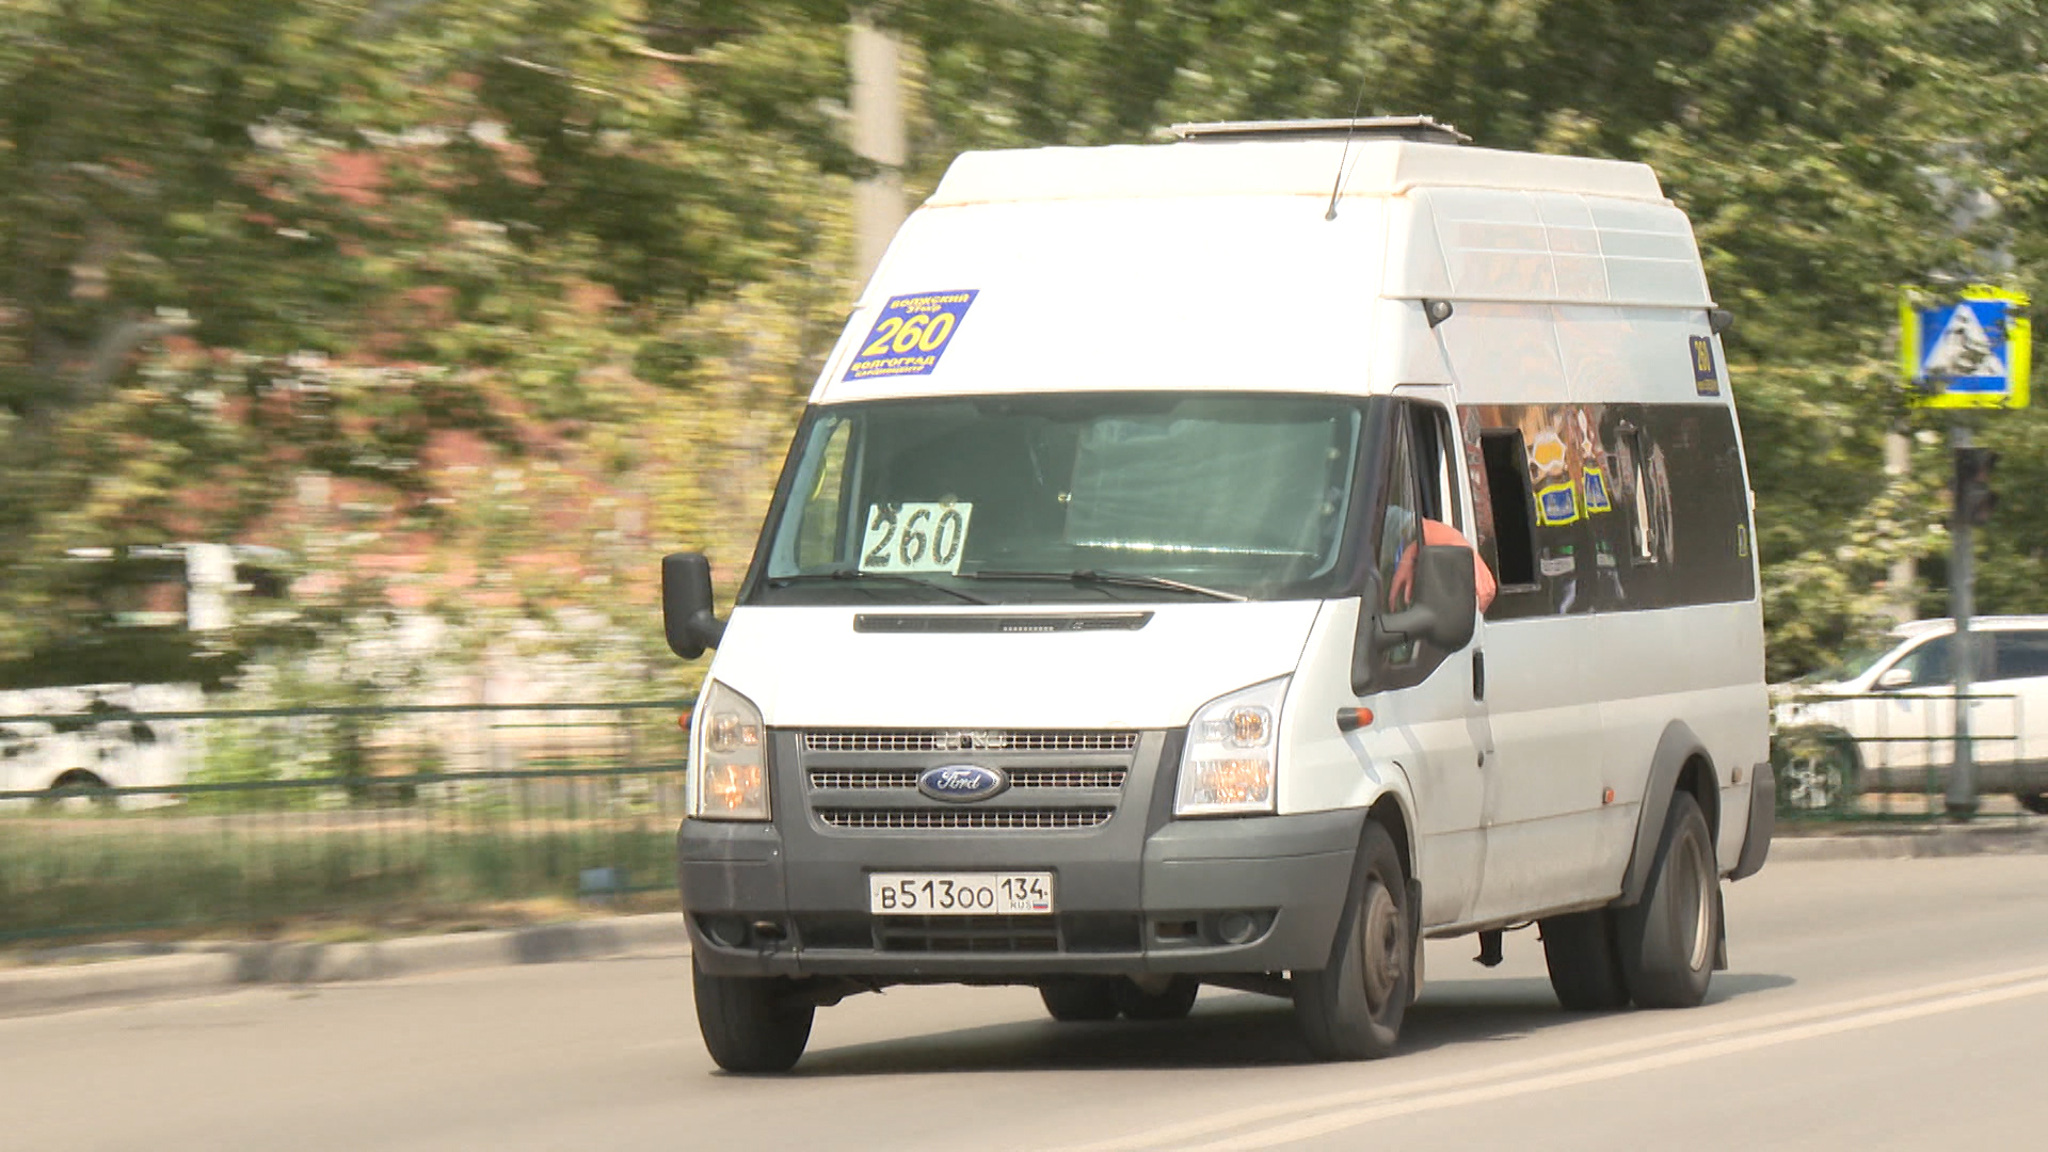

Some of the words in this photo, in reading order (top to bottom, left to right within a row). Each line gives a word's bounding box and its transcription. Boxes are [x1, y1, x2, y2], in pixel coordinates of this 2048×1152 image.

[862, 312, 956, 357] 260
[851, 355, 936, 371] ВОЛГОГРАД
[864, 507, 963, 567] 260
[937, 768, 982, 790] Ford
[1001, 878, 1043, 900] 134
